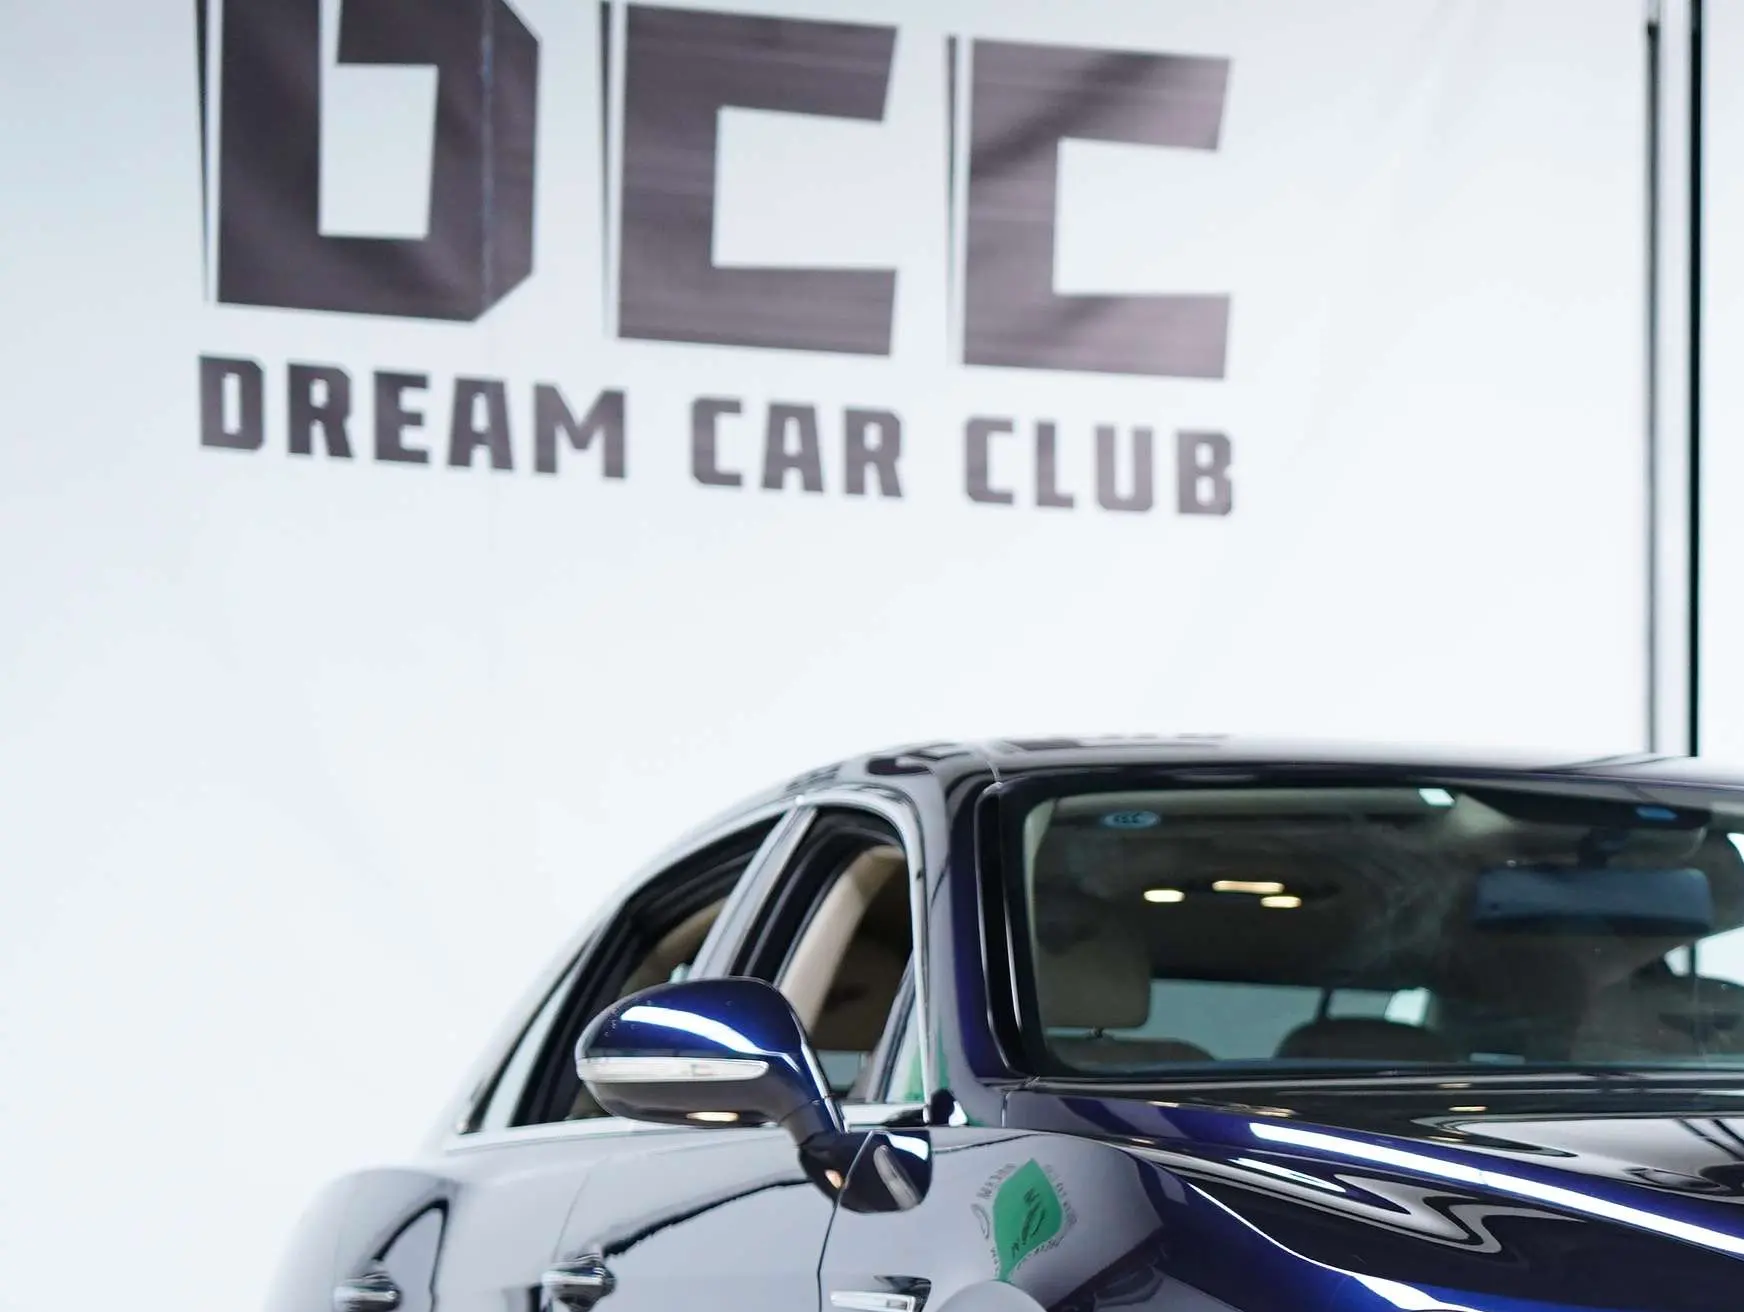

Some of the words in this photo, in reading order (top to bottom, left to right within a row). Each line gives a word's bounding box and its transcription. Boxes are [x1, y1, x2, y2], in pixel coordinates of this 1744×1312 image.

[198, 0, 1233, 380] DCC
[198, 354, 626, 479] DREAM
[691, 395, 904, 498] CAR
[964, 416, 1235, 517] CLUB
